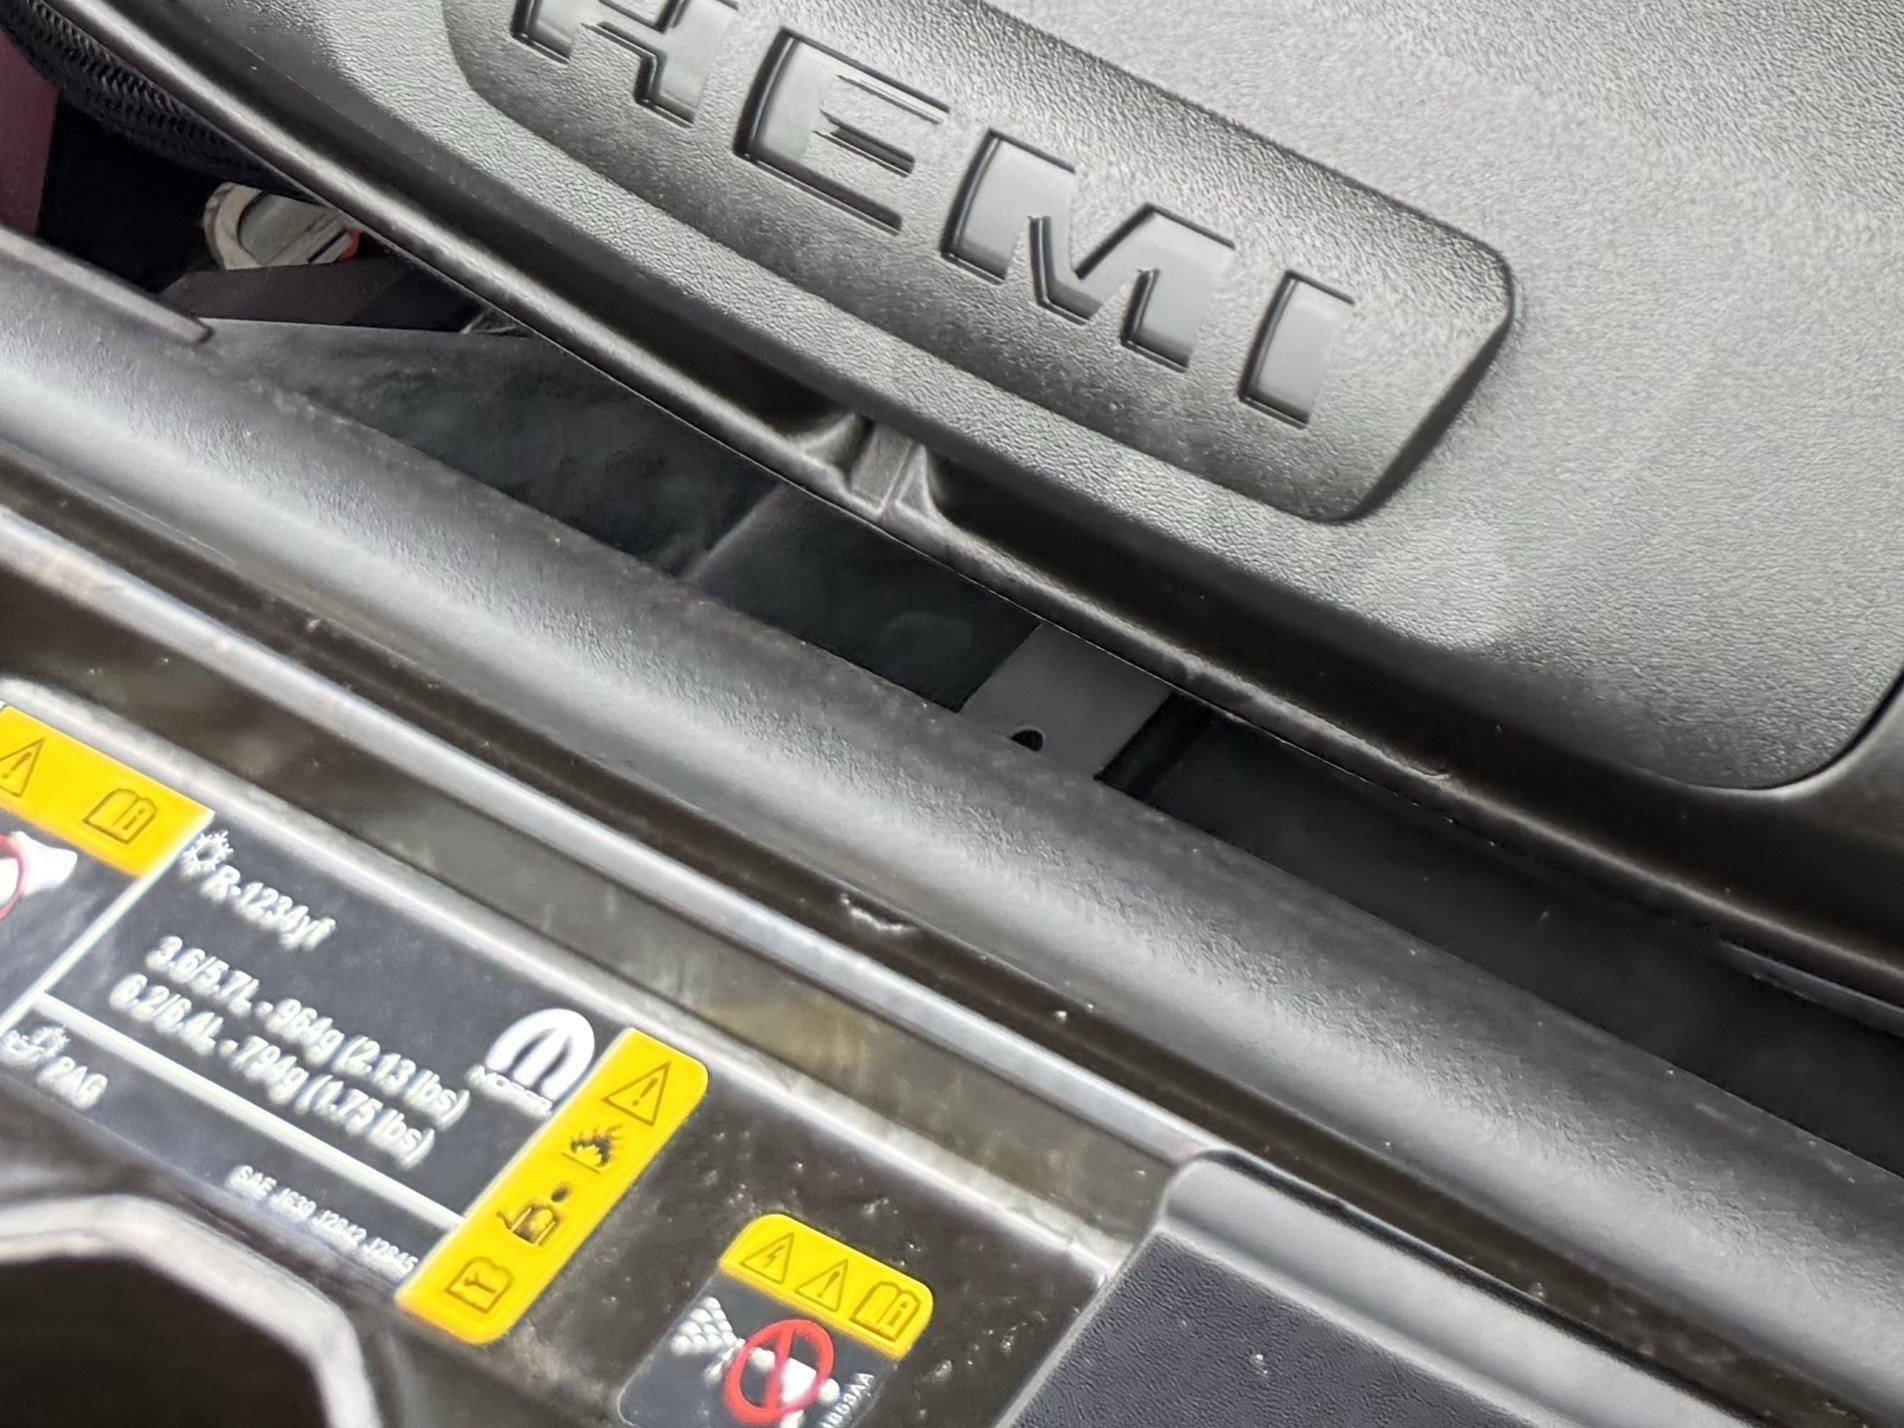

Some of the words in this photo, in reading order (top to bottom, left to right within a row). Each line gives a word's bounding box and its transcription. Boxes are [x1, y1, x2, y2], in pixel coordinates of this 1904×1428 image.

[202, 864, 334, 951] R-1234yf
[110, 973, 223, 1055] 6.2/6.4L
[229, 1036, 310, 1105] 794g
[295, 1074, 383, 1135] (1.75
[368, 1108, 435, 1170] lbs)
[146, 936, 260, 1017] 3.6/5.7L
[265, 999, 345, 1068] 964g
[332, 1035, 417, 1096] (2.13
[404, 1070, 471, 1131] lbs)
[225, 1165, 277, 1200] SAE
